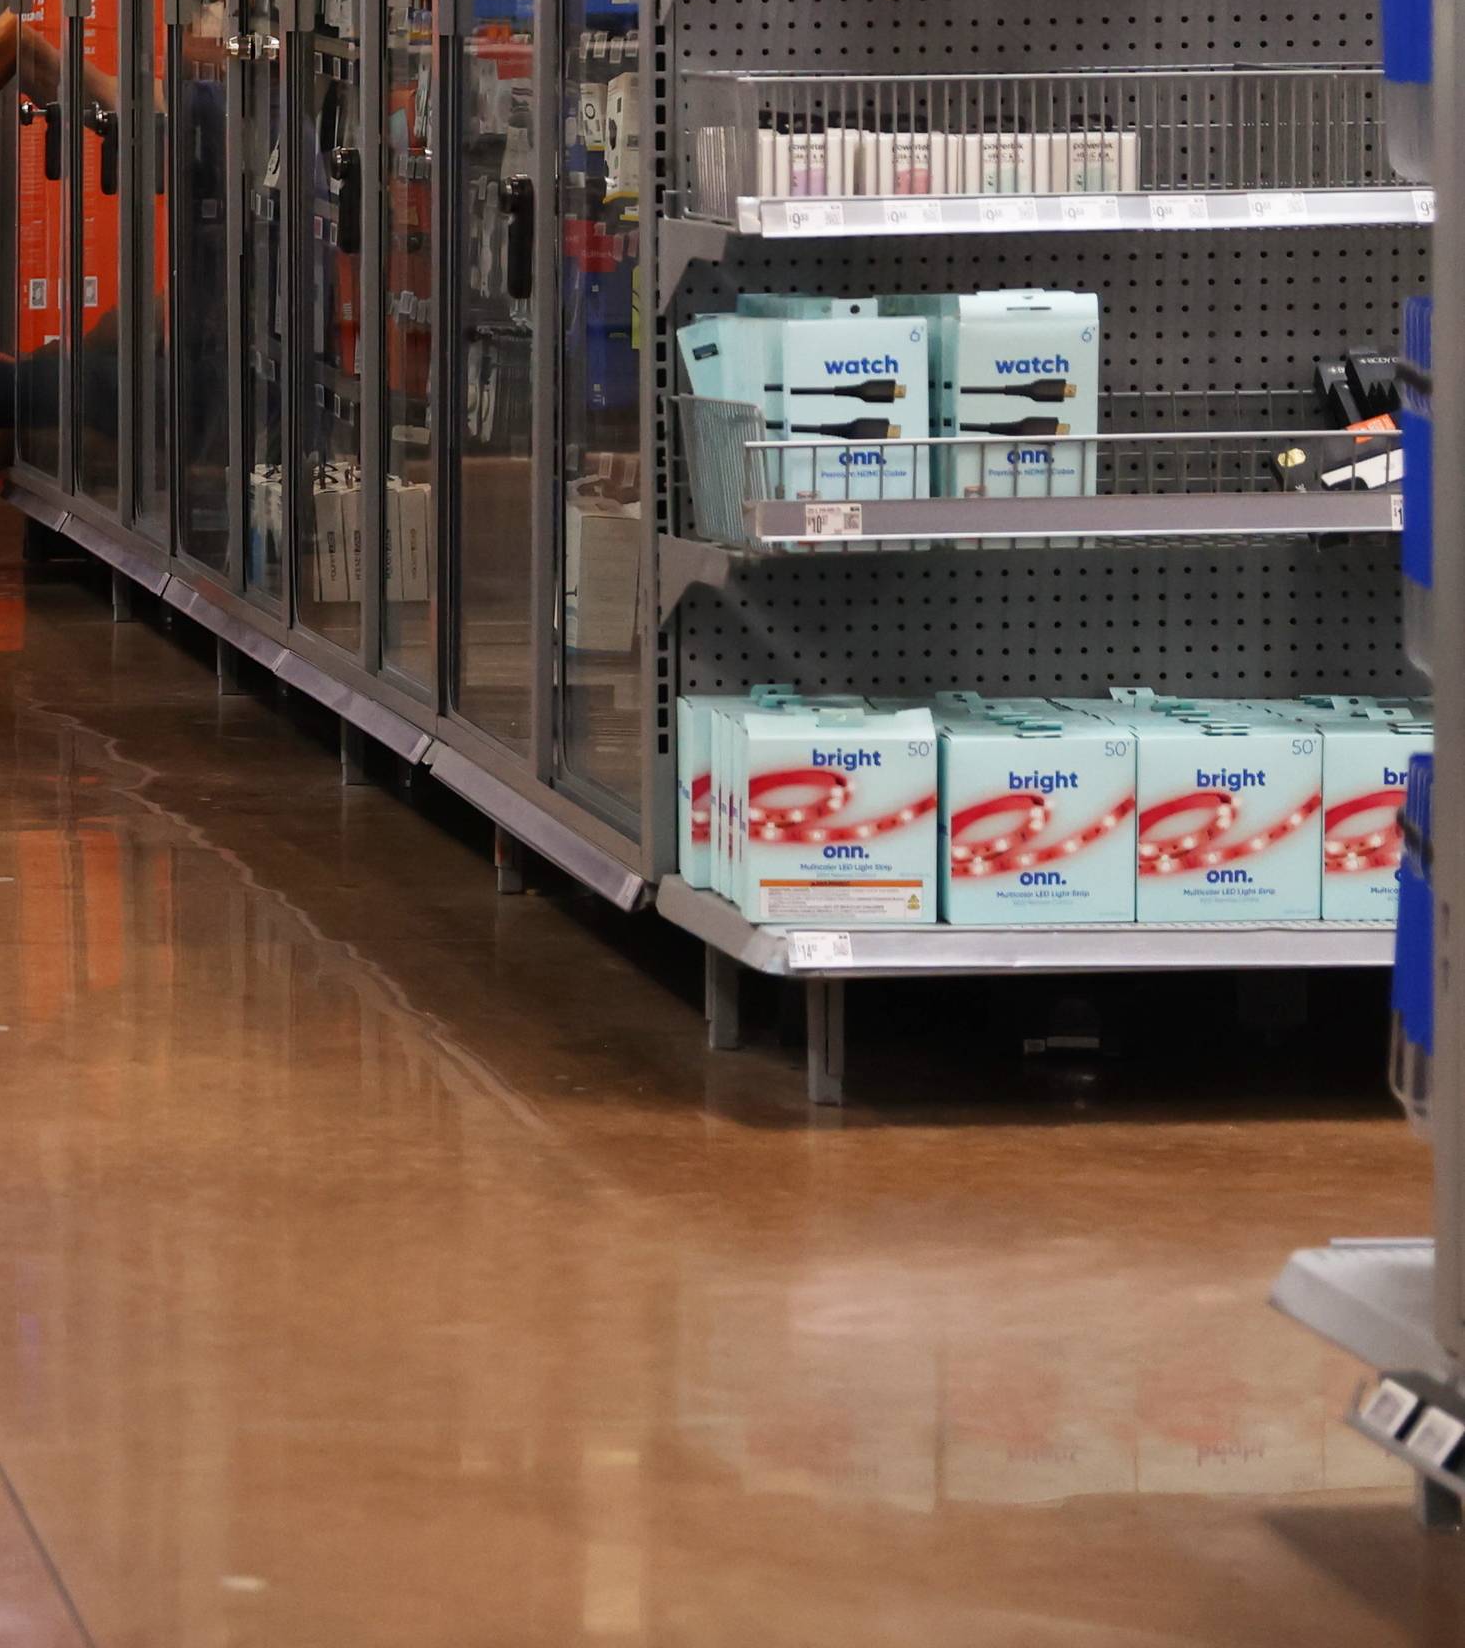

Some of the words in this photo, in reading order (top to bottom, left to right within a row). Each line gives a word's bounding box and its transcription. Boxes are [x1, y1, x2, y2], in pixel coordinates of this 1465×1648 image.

[824, 354, 900, 375] watch
[995, 353, 1070, 374] watch
[838, 450, 887, 466] onn.
[1006, 448, 1055, 464] onn.
[812, 748, 882, 771] bright
[1009, 770, 1078, 794] bright
[1196, 768, 1266, 792] bright
[823, 845, 870, 860] onn.
[1020, 871, 1067, 886] onn.
[1206, 869, 1253, 884] onn.
